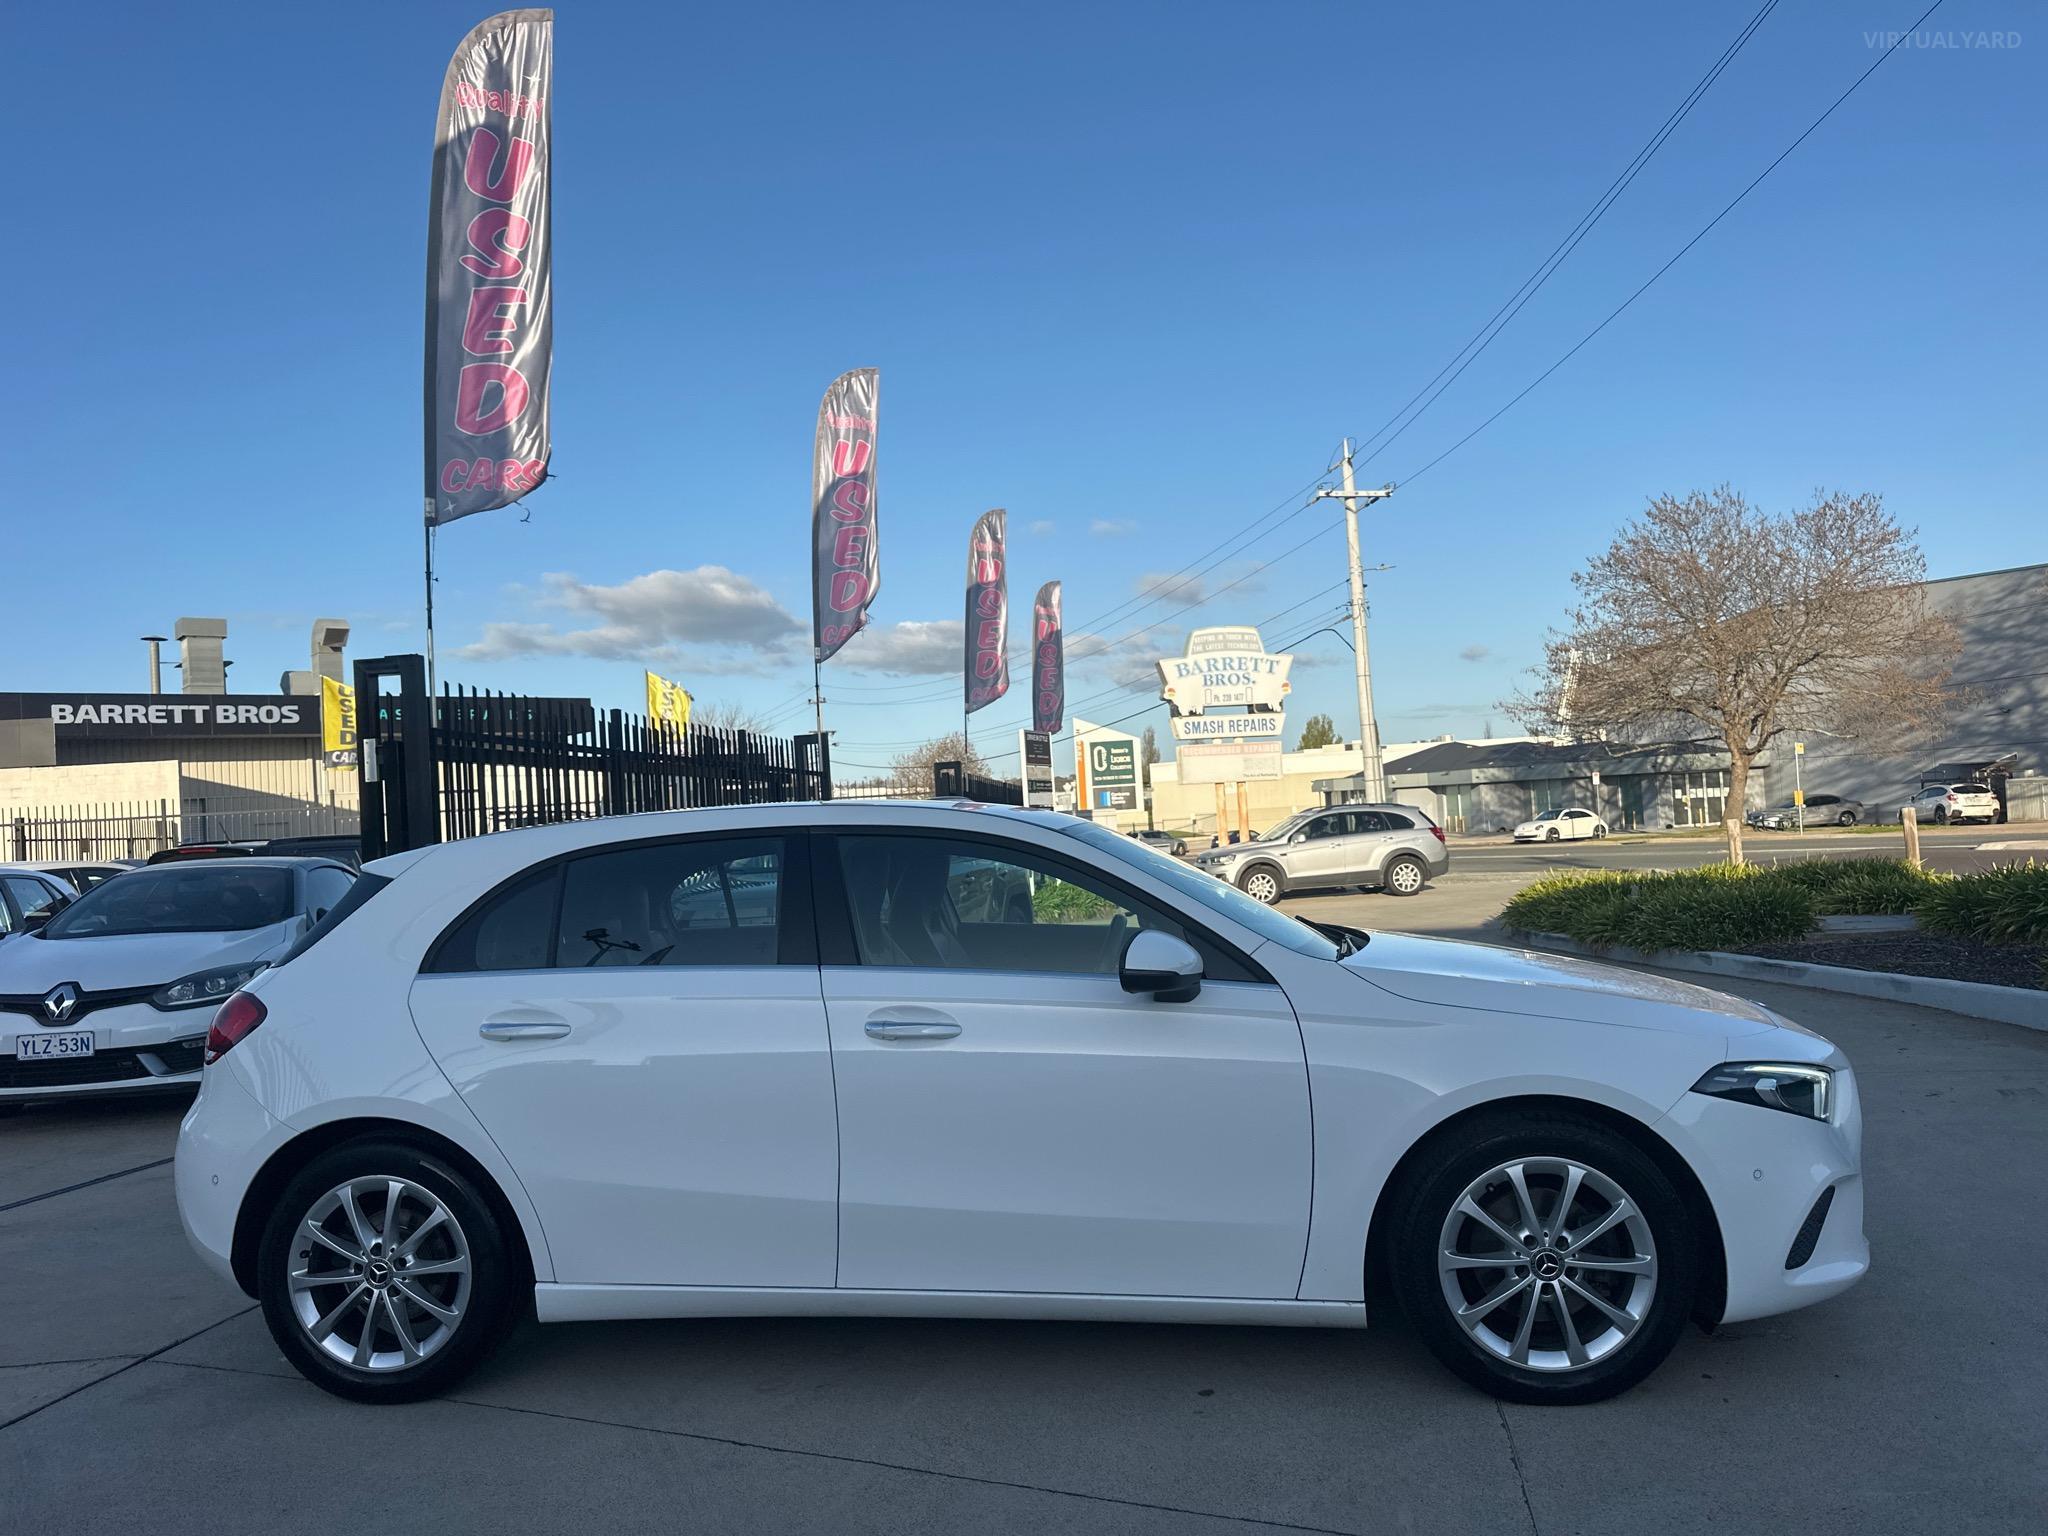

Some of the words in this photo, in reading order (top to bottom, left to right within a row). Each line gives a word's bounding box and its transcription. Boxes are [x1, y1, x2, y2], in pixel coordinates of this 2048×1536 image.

[455, 82, 545, 123] Quality
[455, 126, 536, 437] USED
[441, 457, 546, 494] CARS
[830, 439, 871, 613] USED
[975, 558, 1003, 680] USED
[1038, 619, 1059, 716] USED
[1175, 656, 1281, 678] BARRETT
[1203, 672, 1257, 687] BROS.
[51, 704, 210, 724] BARRETT
[216, 704, 300, 724] BROS
[338, 685, 357, 745] USED
[1184, 719, 1224, 735] SMASH
[1229, 718, 1276, 733] REPAIRS
[332, 751, 358, 763] CAR
